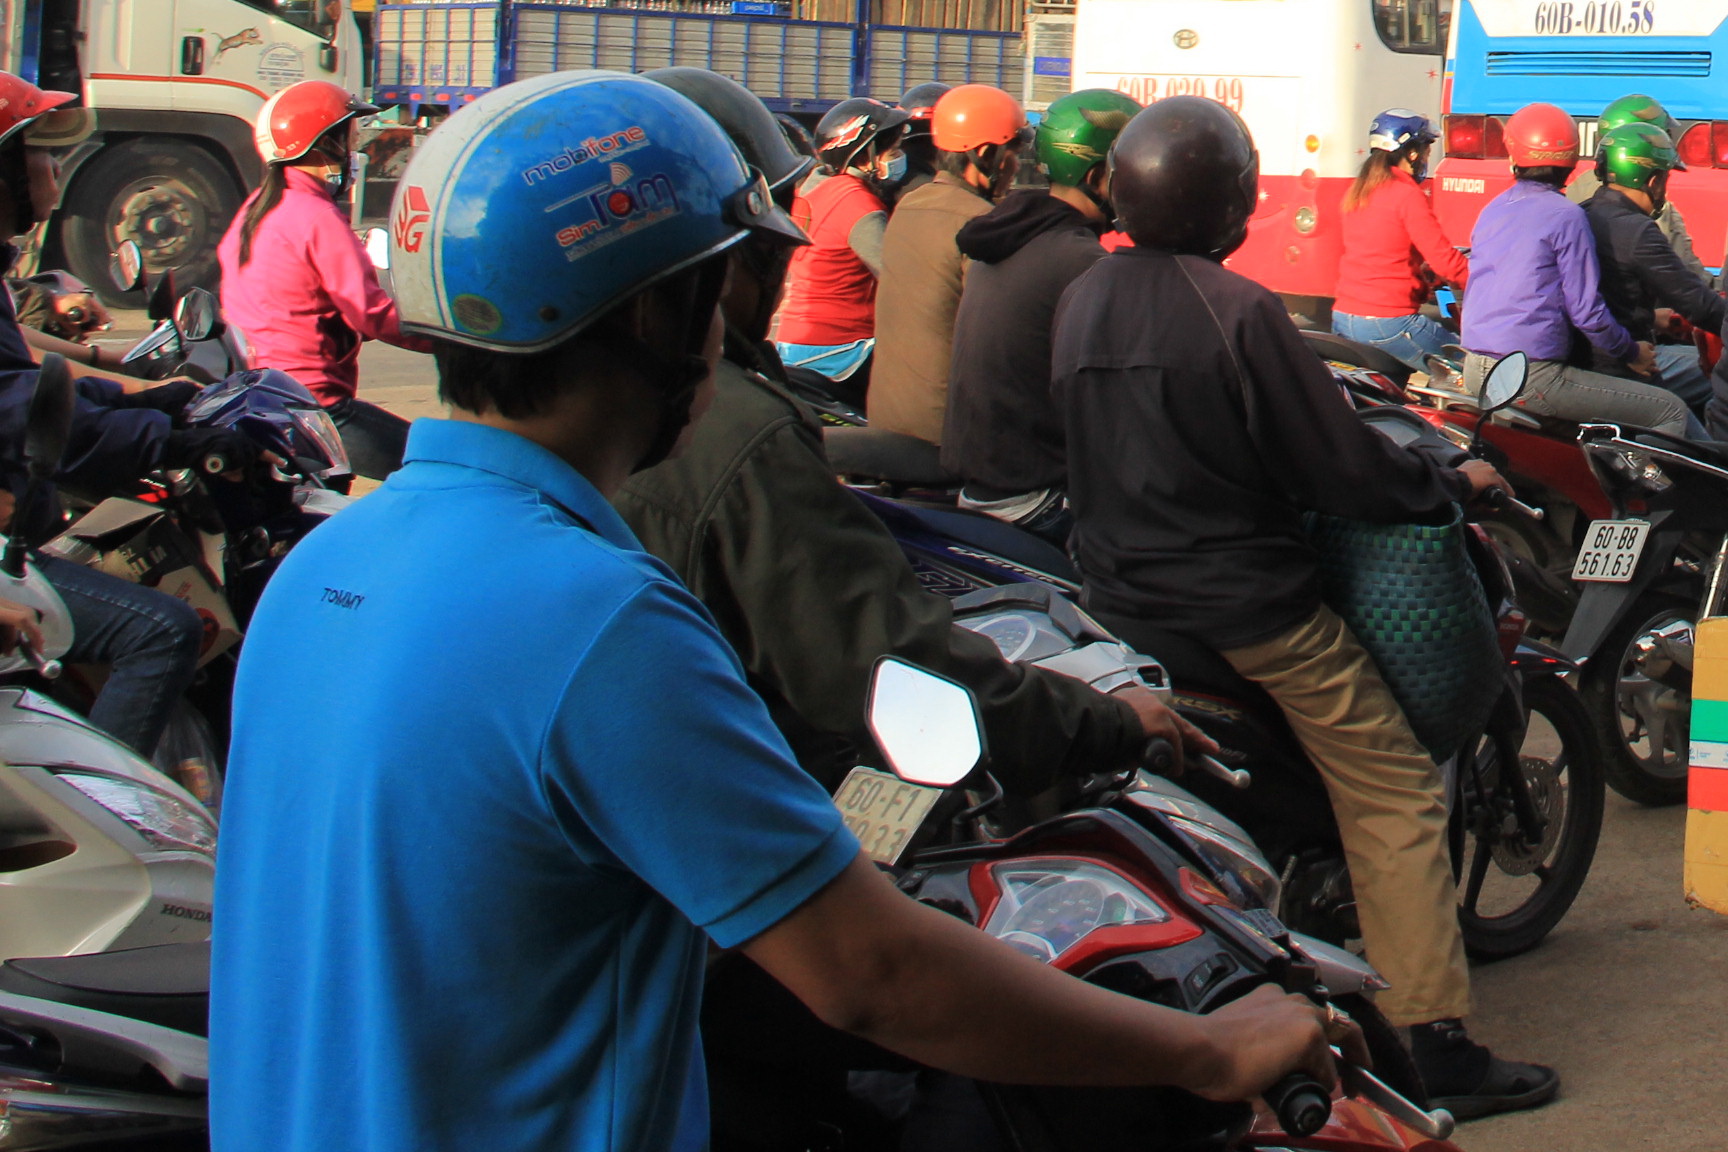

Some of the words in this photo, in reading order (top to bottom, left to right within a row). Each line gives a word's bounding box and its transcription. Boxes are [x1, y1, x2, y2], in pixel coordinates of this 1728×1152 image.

[1534, 0, 1655, 34] 60B-010.58
[522, 126, 646, 186] mobifone
[1442, 178, 1485, 194] HYUNDAI
[1594, 525, 1639, 549] 60-B8
[1578, 551, 1635, 577] 561.63
[321, 587, 365, 610] TOMMY
[846, 777, 922, 822] 60-F1
[160, 903, 213, 923] HONDA
